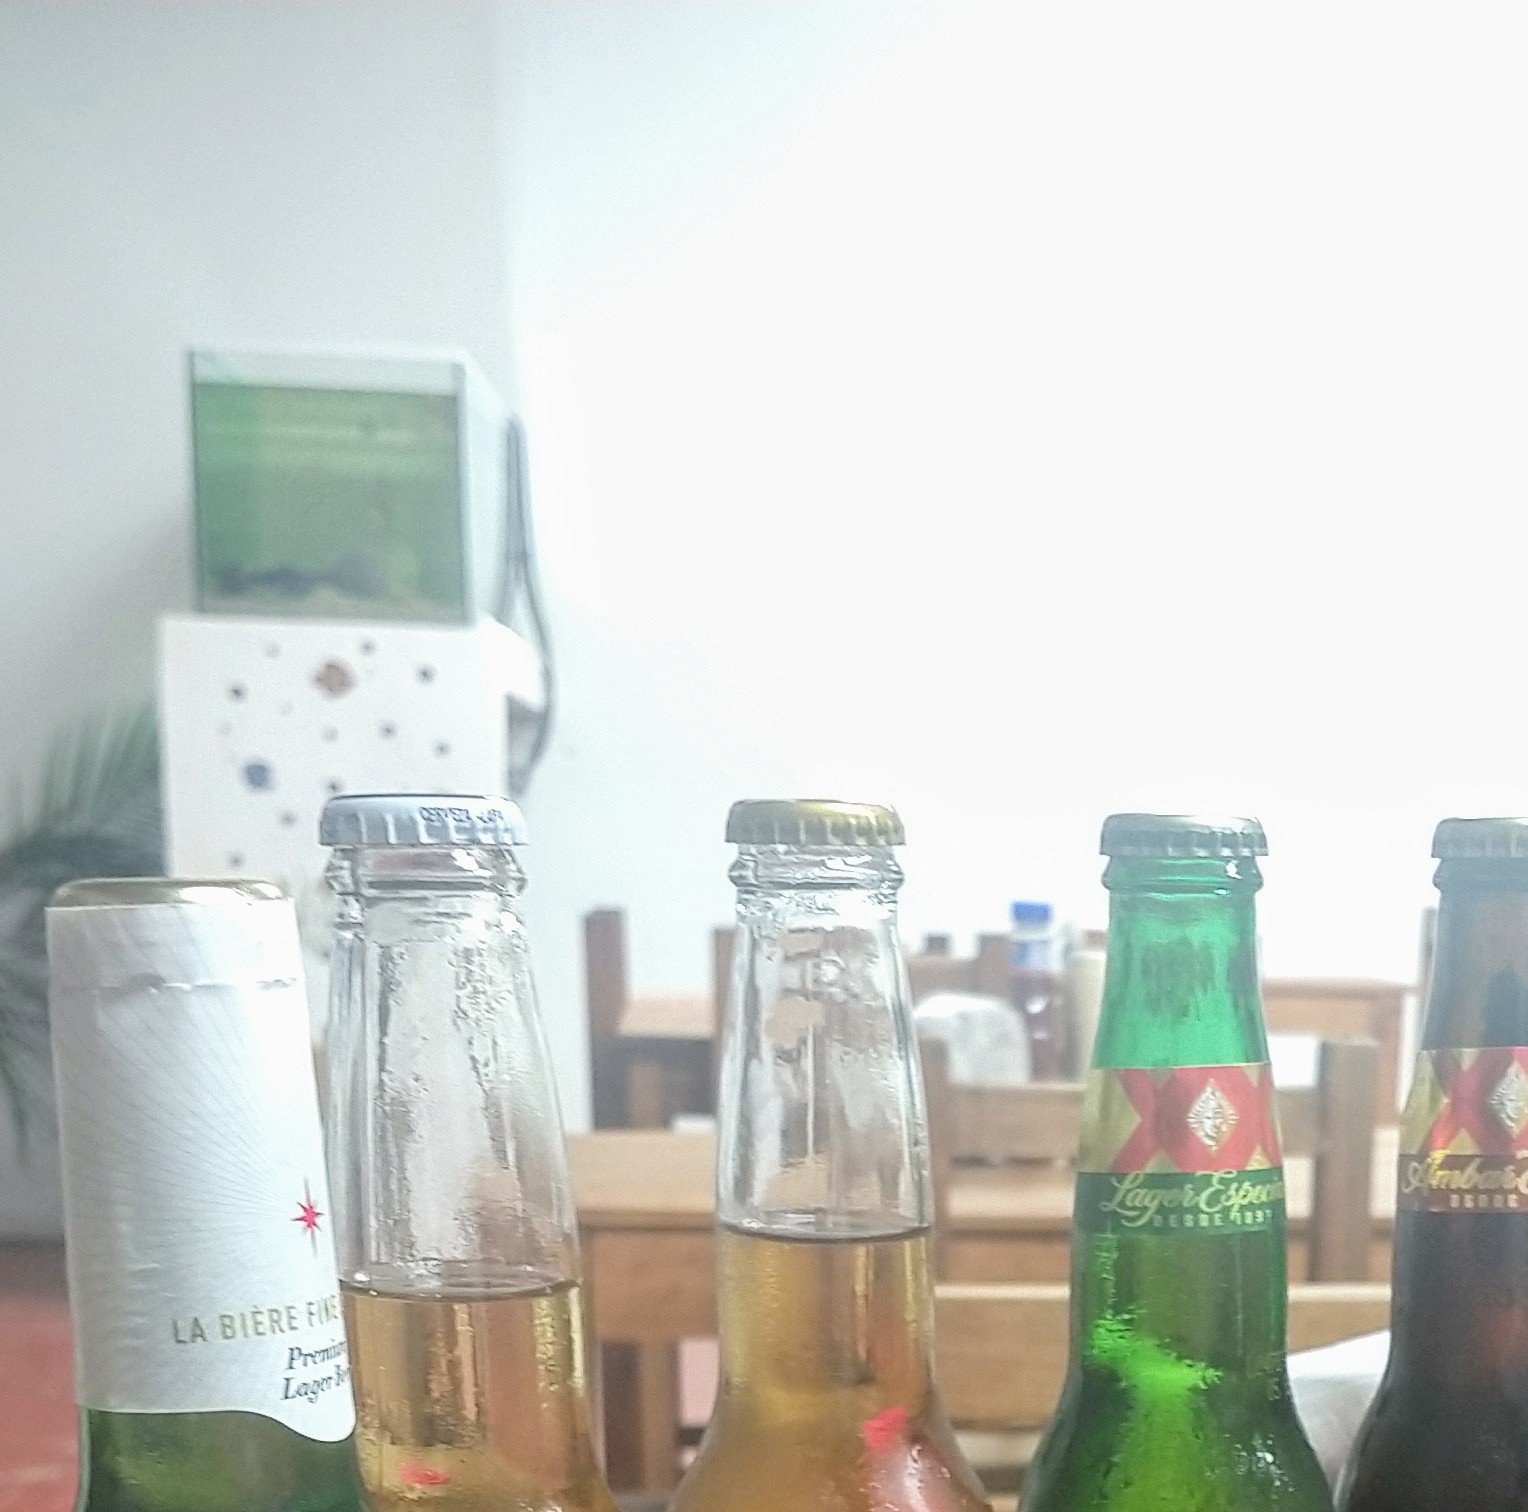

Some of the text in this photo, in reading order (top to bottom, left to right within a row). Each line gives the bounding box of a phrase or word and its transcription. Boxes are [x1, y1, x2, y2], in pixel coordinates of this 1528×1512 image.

[1100, 1170, 1199, 1227] Lager
[172, 1316, 208, 1344] LA
[219, 1304, 299, 1340] BIÈRE
